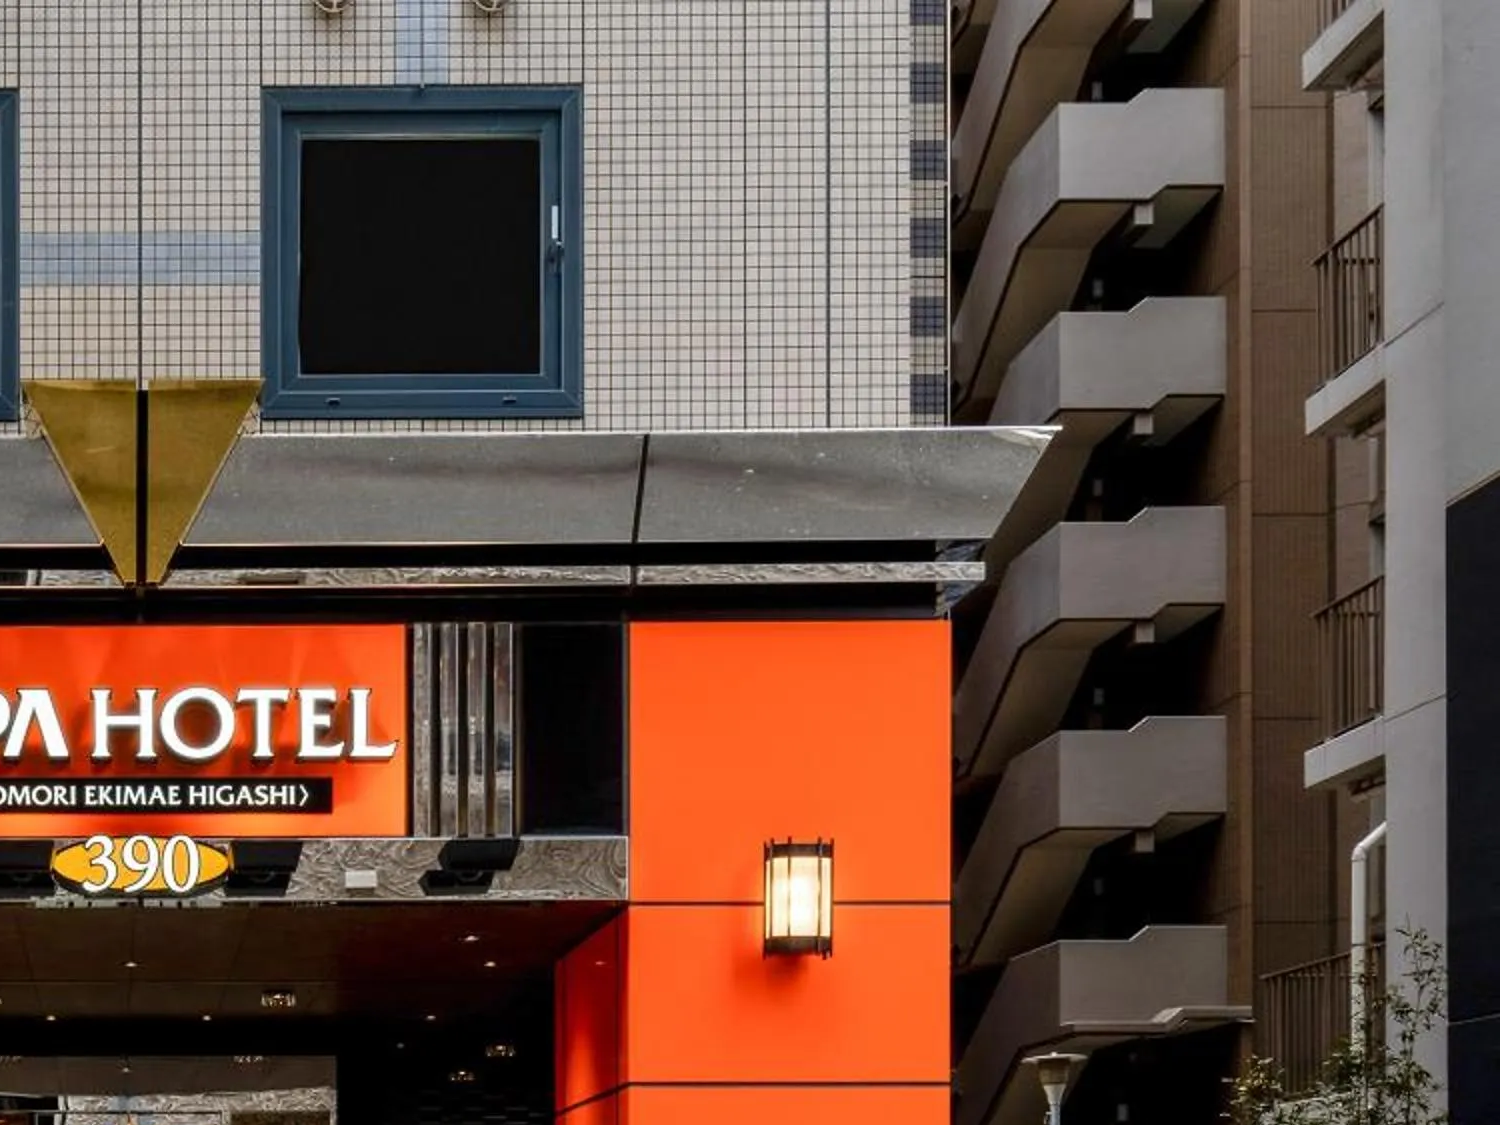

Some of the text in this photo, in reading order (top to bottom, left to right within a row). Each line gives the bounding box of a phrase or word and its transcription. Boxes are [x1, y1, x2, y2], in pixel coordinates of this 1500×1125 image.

[91, 686, 400, 760] HOTEL
[84, 784, 182, 806] EKIMAE
[81, 834, 201, 893] 390
